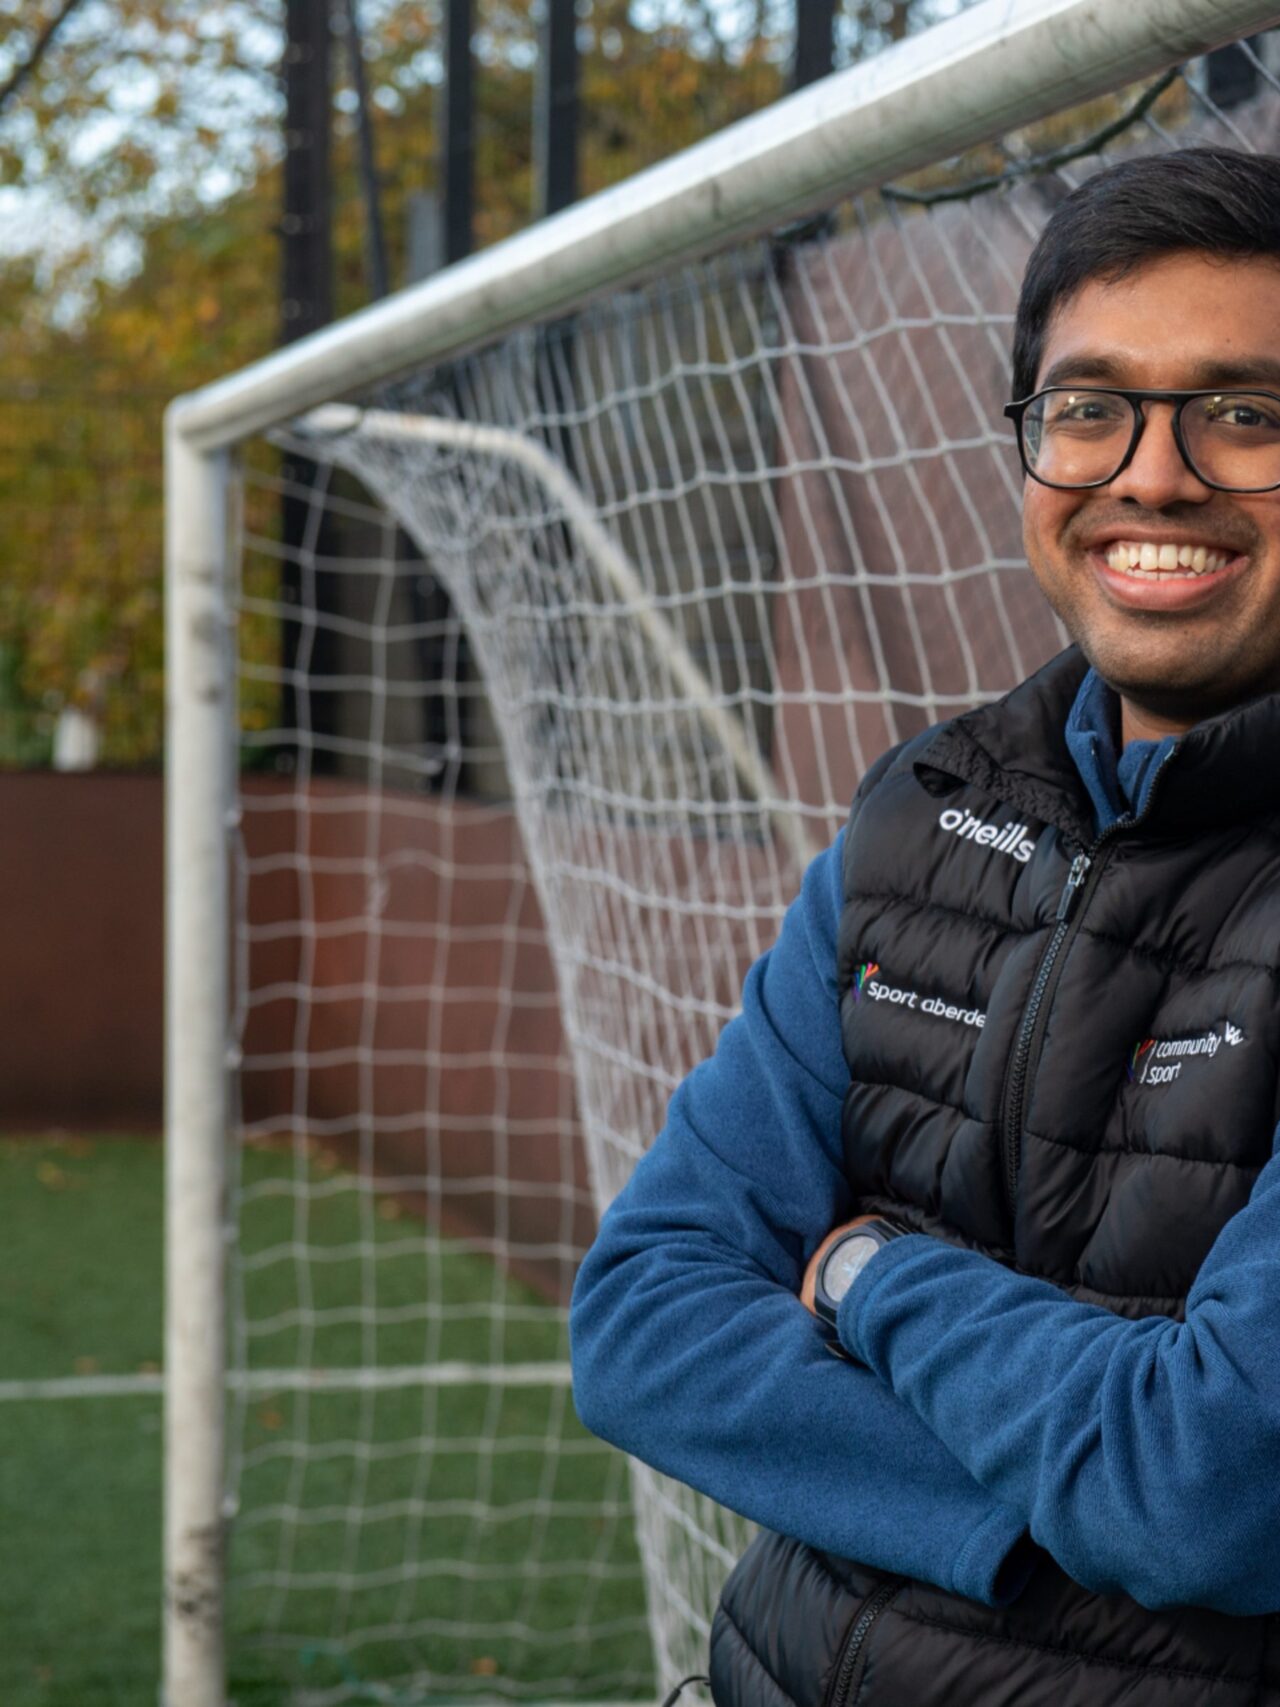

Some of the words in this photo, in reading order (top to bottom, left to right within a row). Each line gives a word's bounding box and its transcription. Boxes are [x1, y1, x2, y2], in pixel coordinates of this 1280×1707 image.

[939, 808, 1036, 863] o'neills
[867, 980, 918, 1009] sport
[1156, 1031, 1222, 1058] community
[1146, 1061, 1182, 1087] sport
